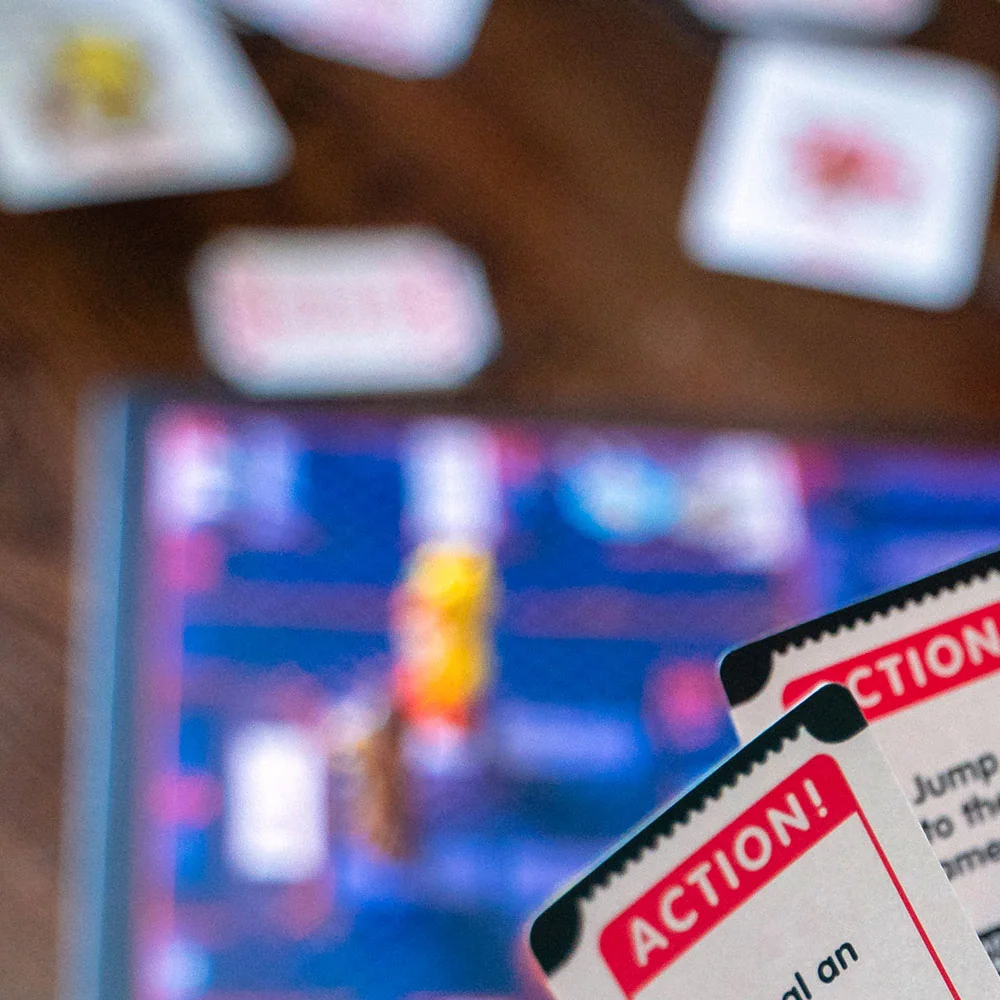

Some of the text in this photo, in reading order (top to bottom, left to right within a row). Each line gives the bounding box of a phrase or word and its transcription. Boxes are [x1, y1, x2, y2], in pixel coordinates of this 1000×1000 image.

[913, 752, 999, 805] Jump
[920, 814, 955, 844] to
[628, 778, 828, 968] ACTION!
[817, 941, 859, 984] an
